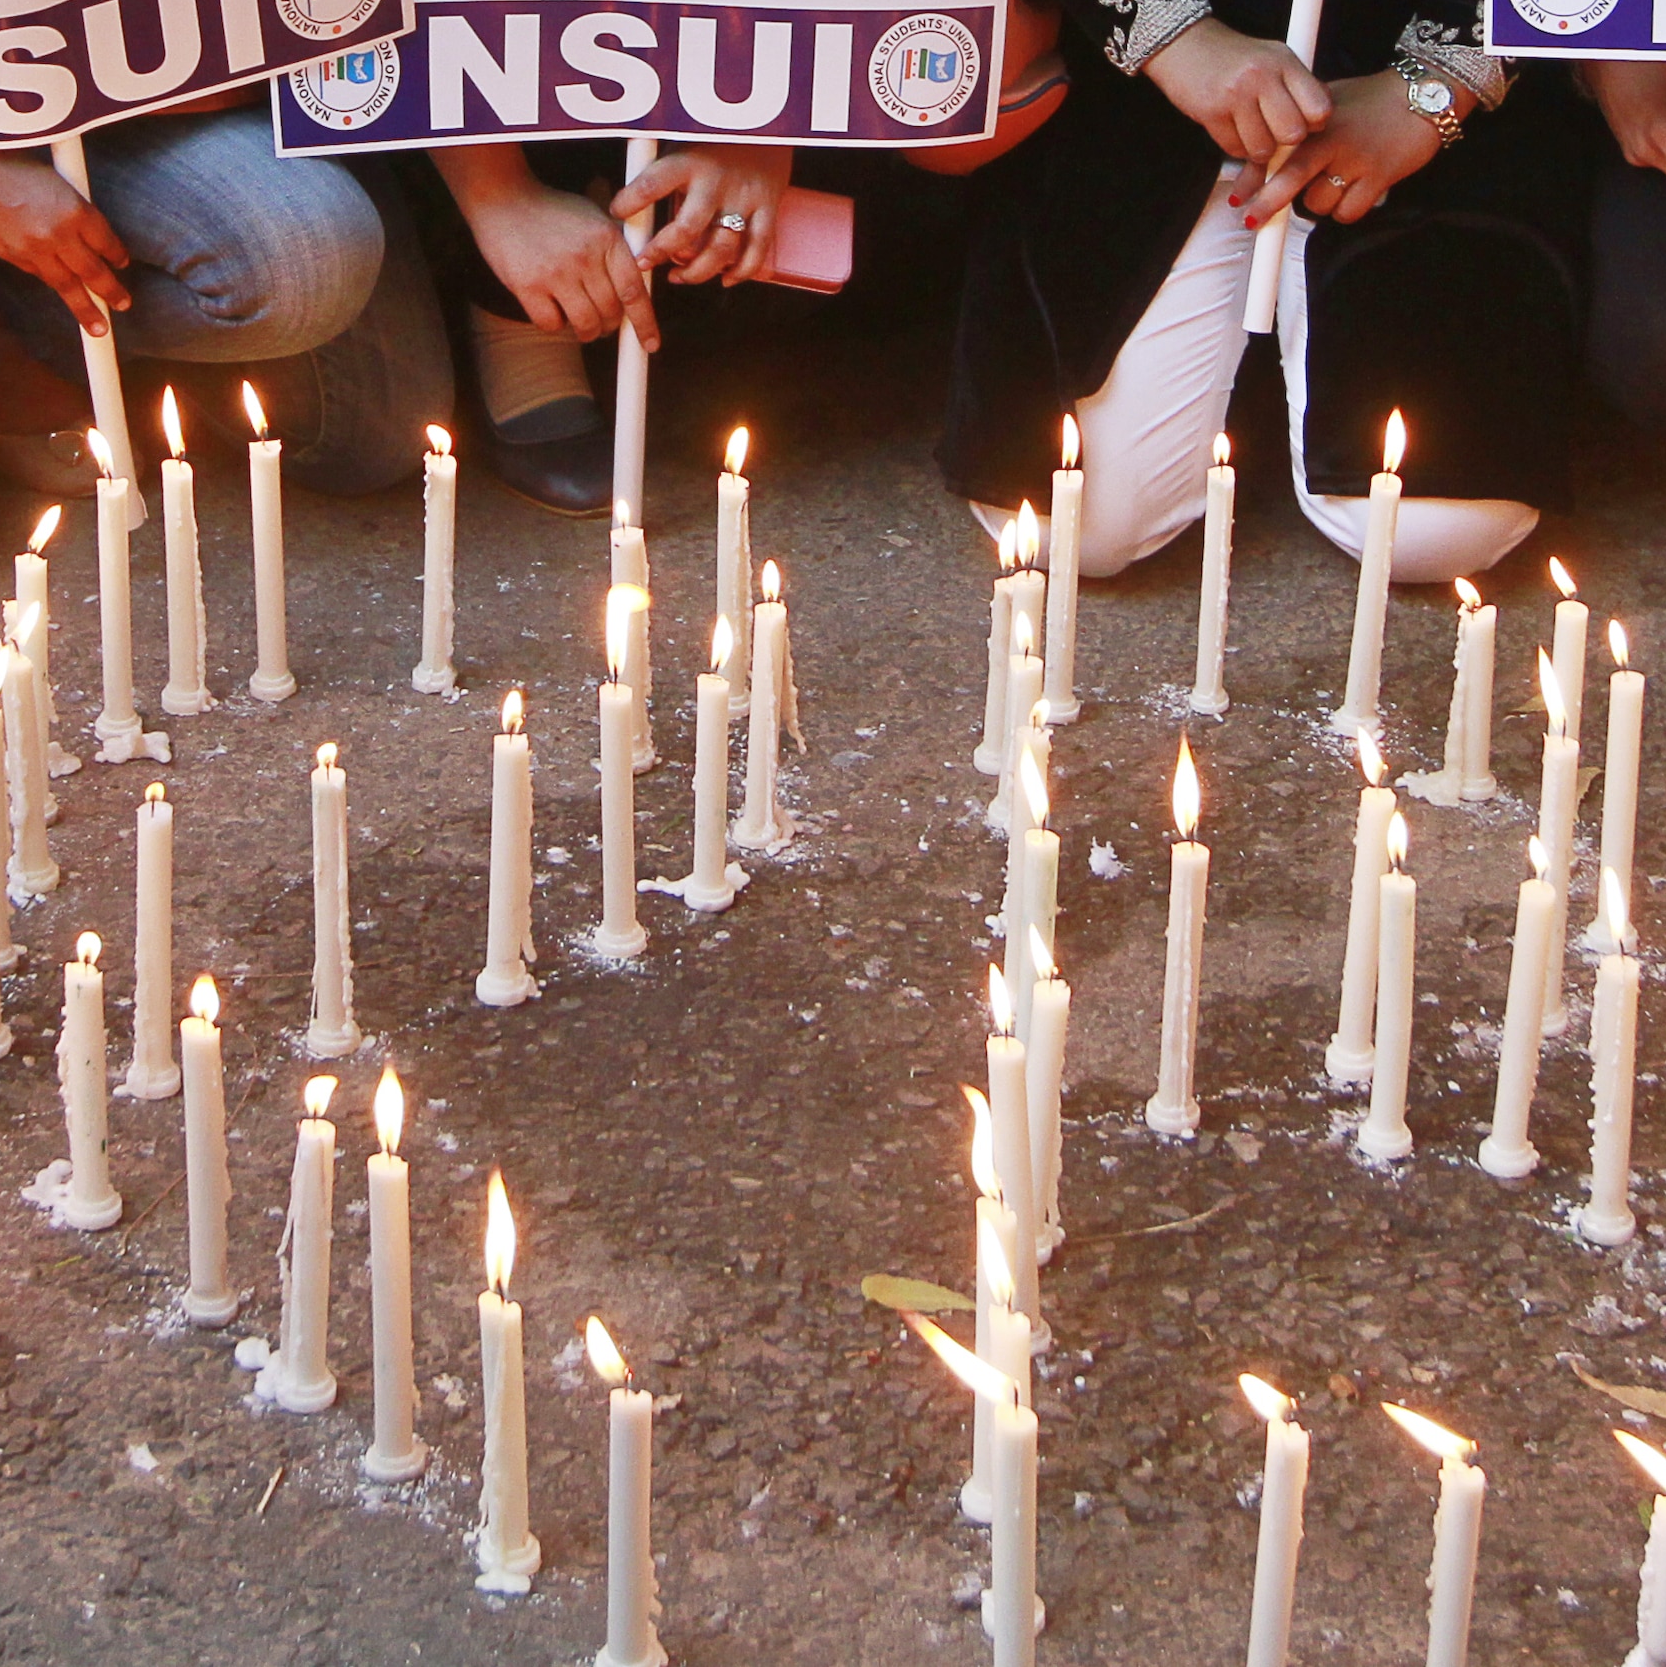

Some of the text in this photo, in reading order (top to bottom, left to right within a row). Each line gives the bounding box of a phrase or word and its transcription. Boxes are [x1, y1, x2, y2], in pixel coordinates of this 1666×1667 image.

[429, 13, 853, 132] NSUI
[871, 16, 976, 119] NATIONAL STUDENTS' UNION OF INDIA
